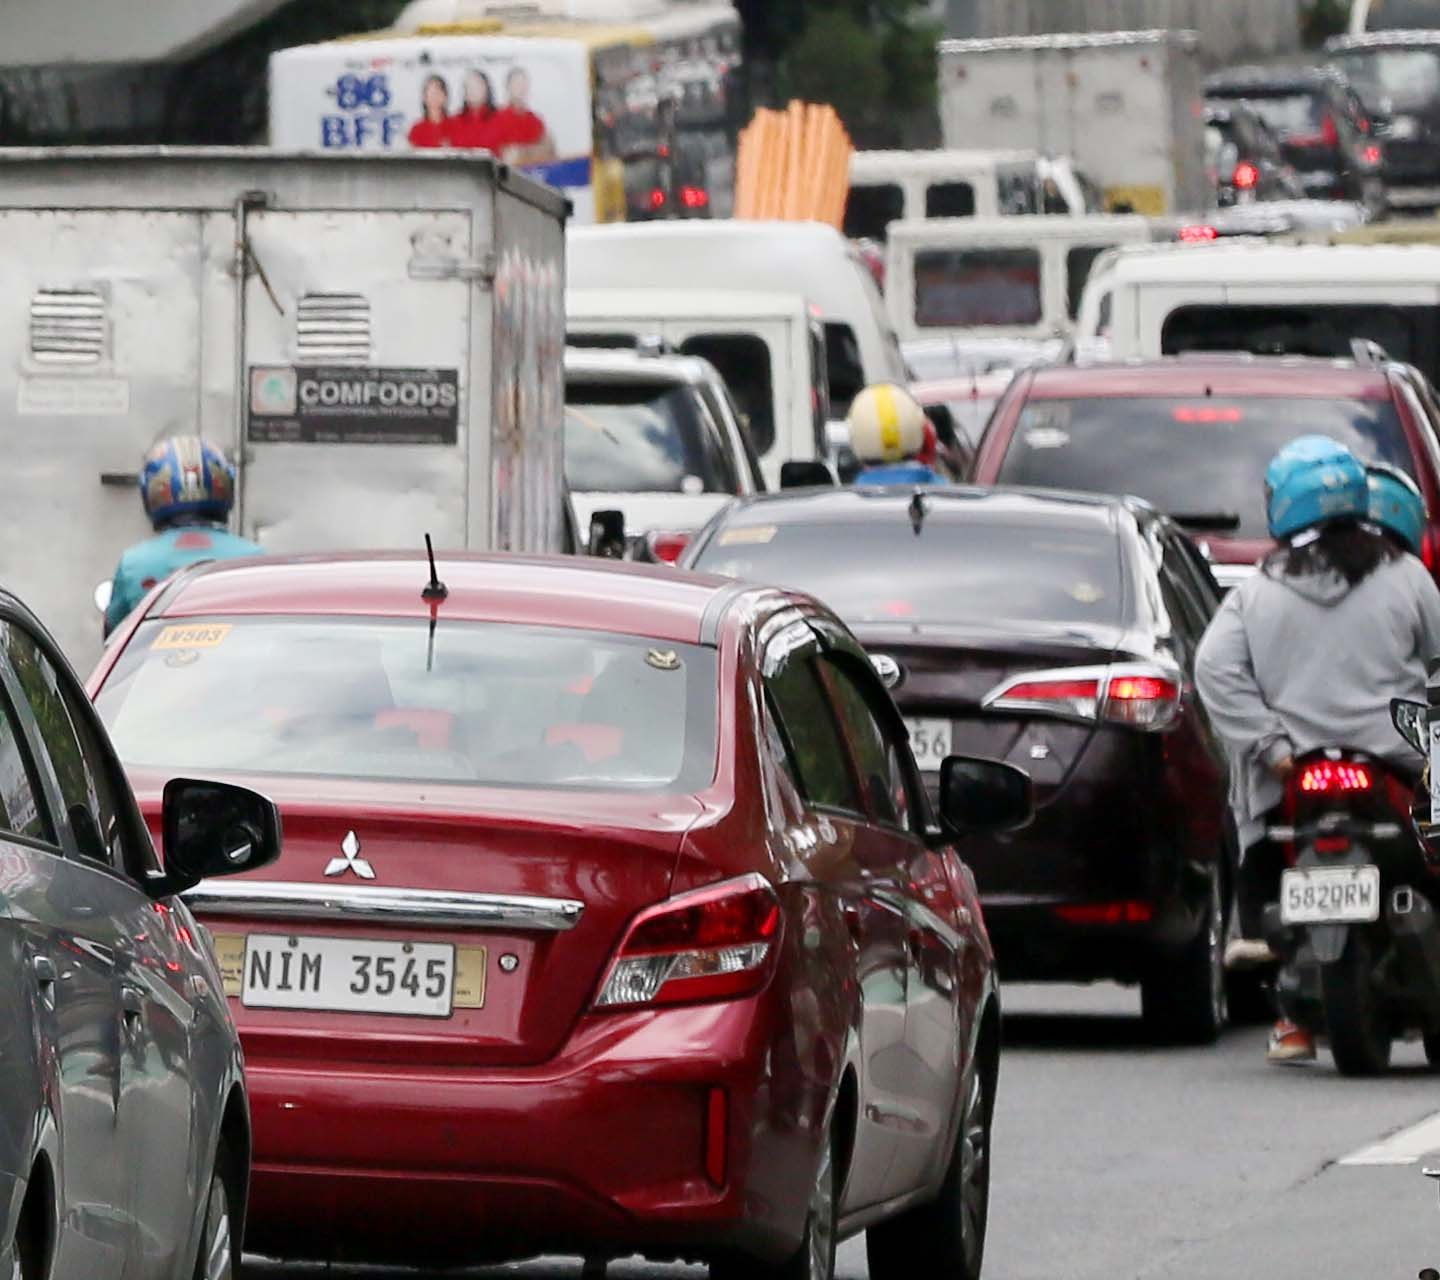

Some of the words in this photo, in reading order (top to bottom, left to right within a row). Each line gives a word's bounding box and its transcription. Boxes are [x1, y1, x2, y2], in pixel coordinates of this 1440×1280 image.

[320, 112, 405, 149] BFF
[299, 380, 457, 408] COMFOODS
[248, 949, 323, 993] NIM
[349, 954, 447, 998] 3545
